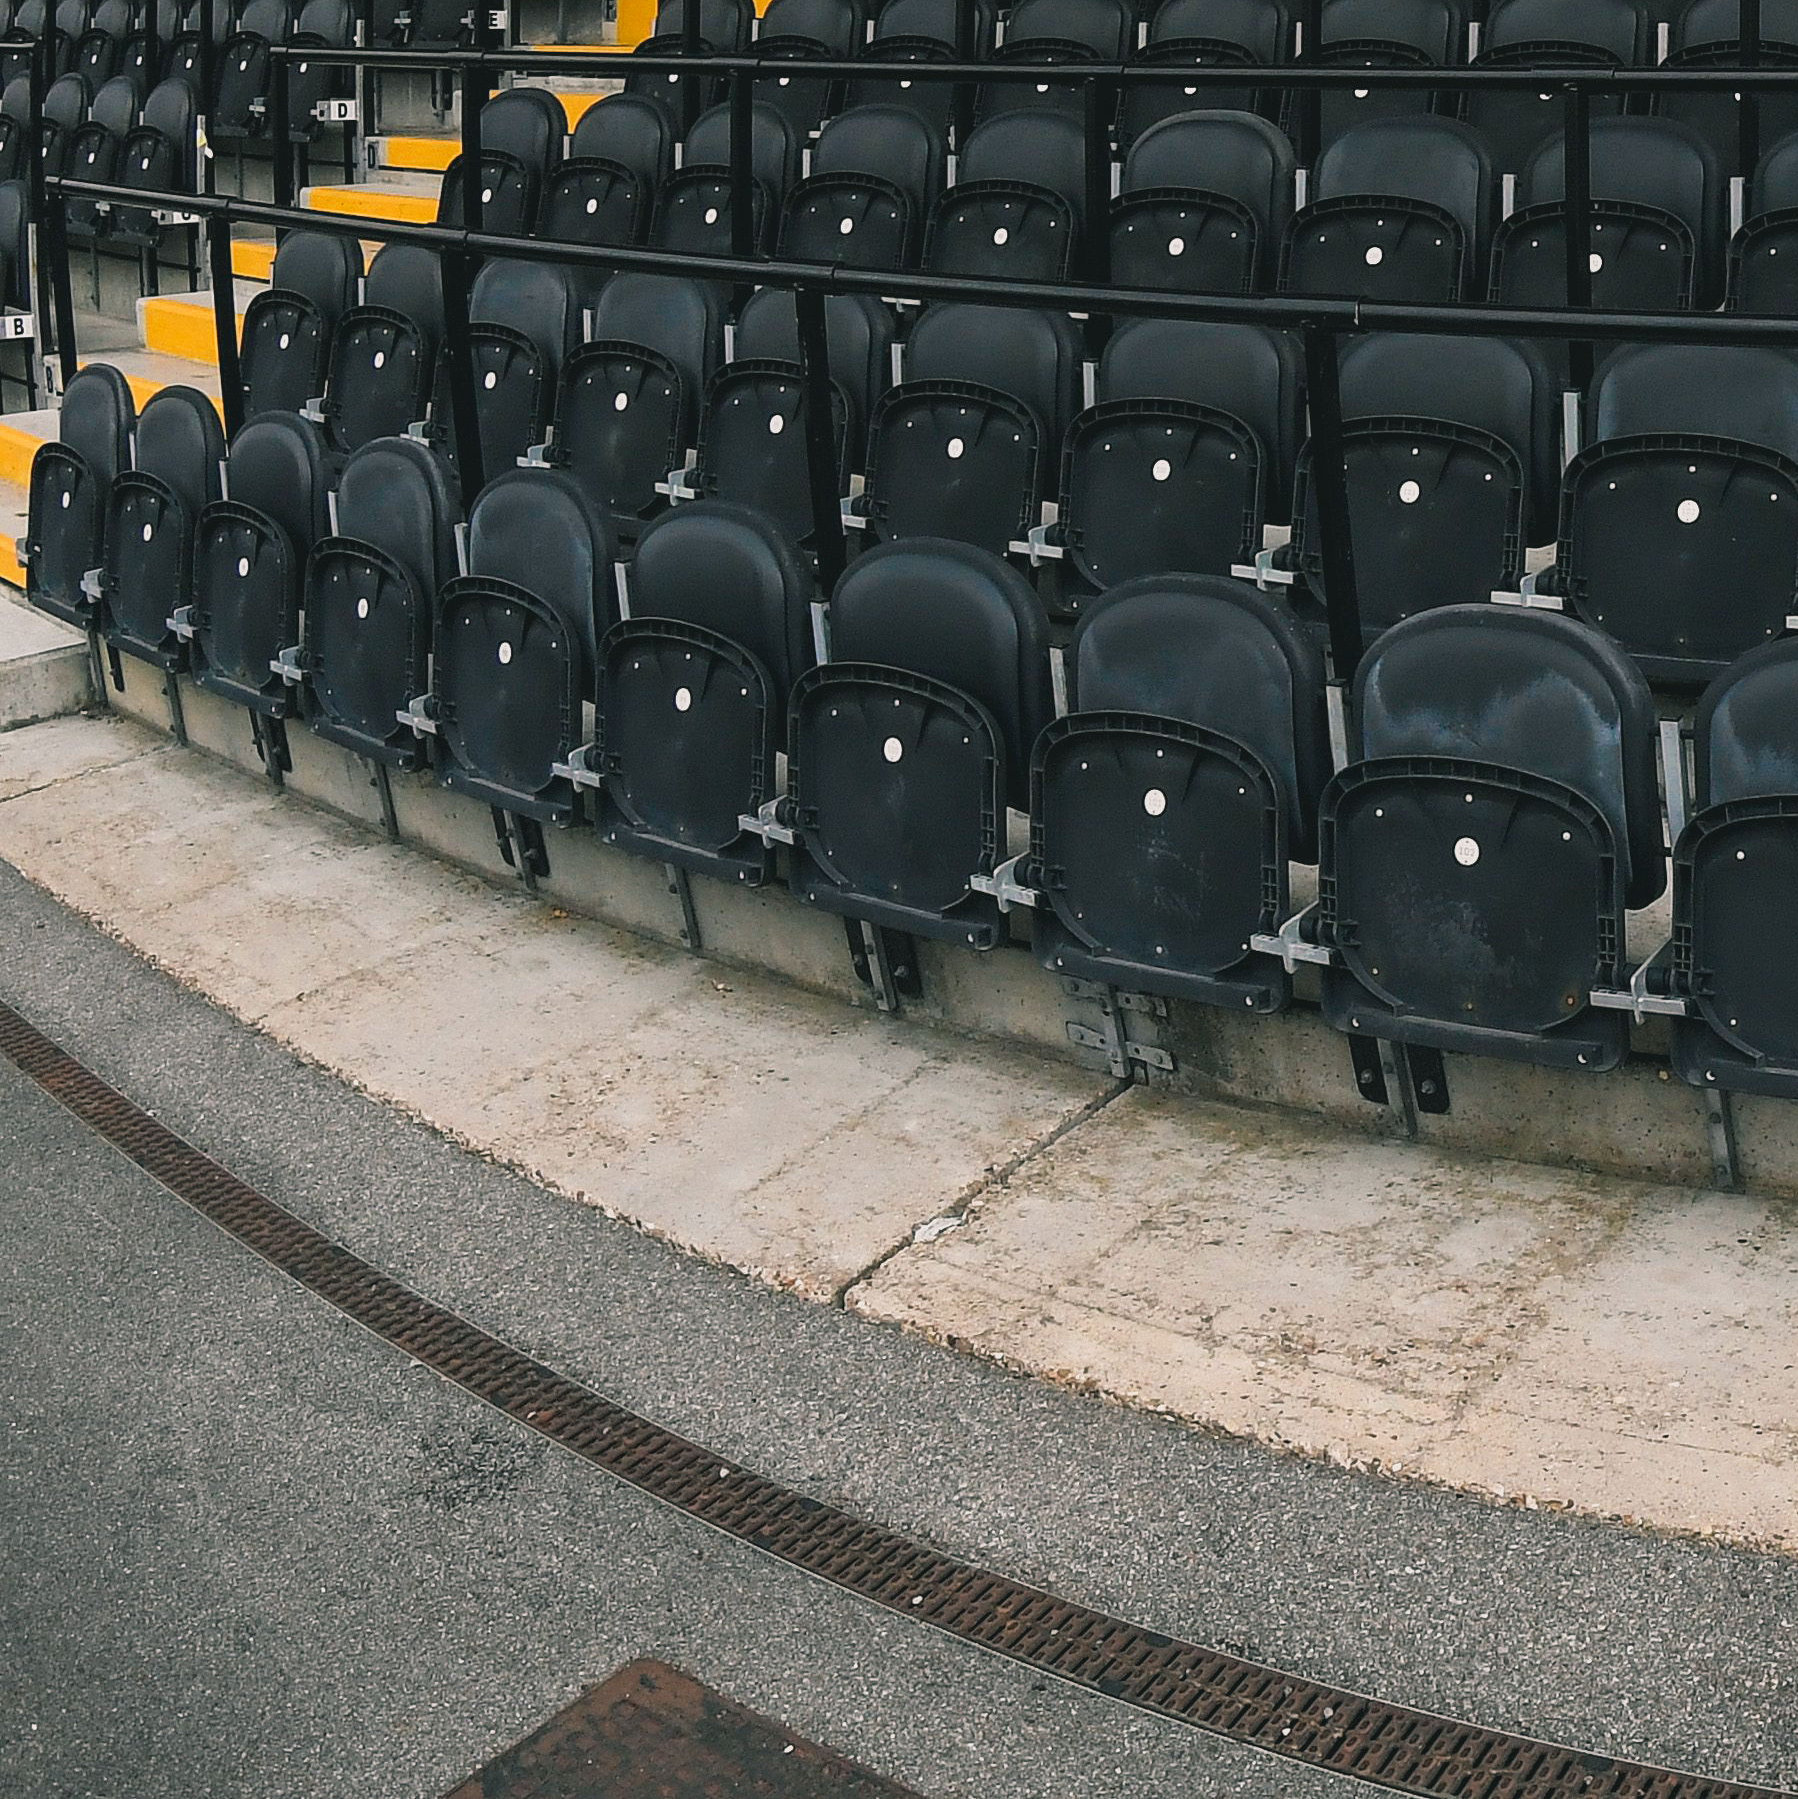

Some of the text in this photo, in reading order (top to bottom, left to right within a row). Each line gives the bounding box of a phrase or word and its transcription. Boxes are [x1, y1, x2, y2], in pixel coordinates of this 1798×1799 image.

[489, 12, 498, 27] E
[337, 103, 348, 118] D
[367, 143, 376, 169] D
[13, 318, 25, 335] B
[45, 366, 53, 393] B
[1459, 846, 1475, 858] 102
